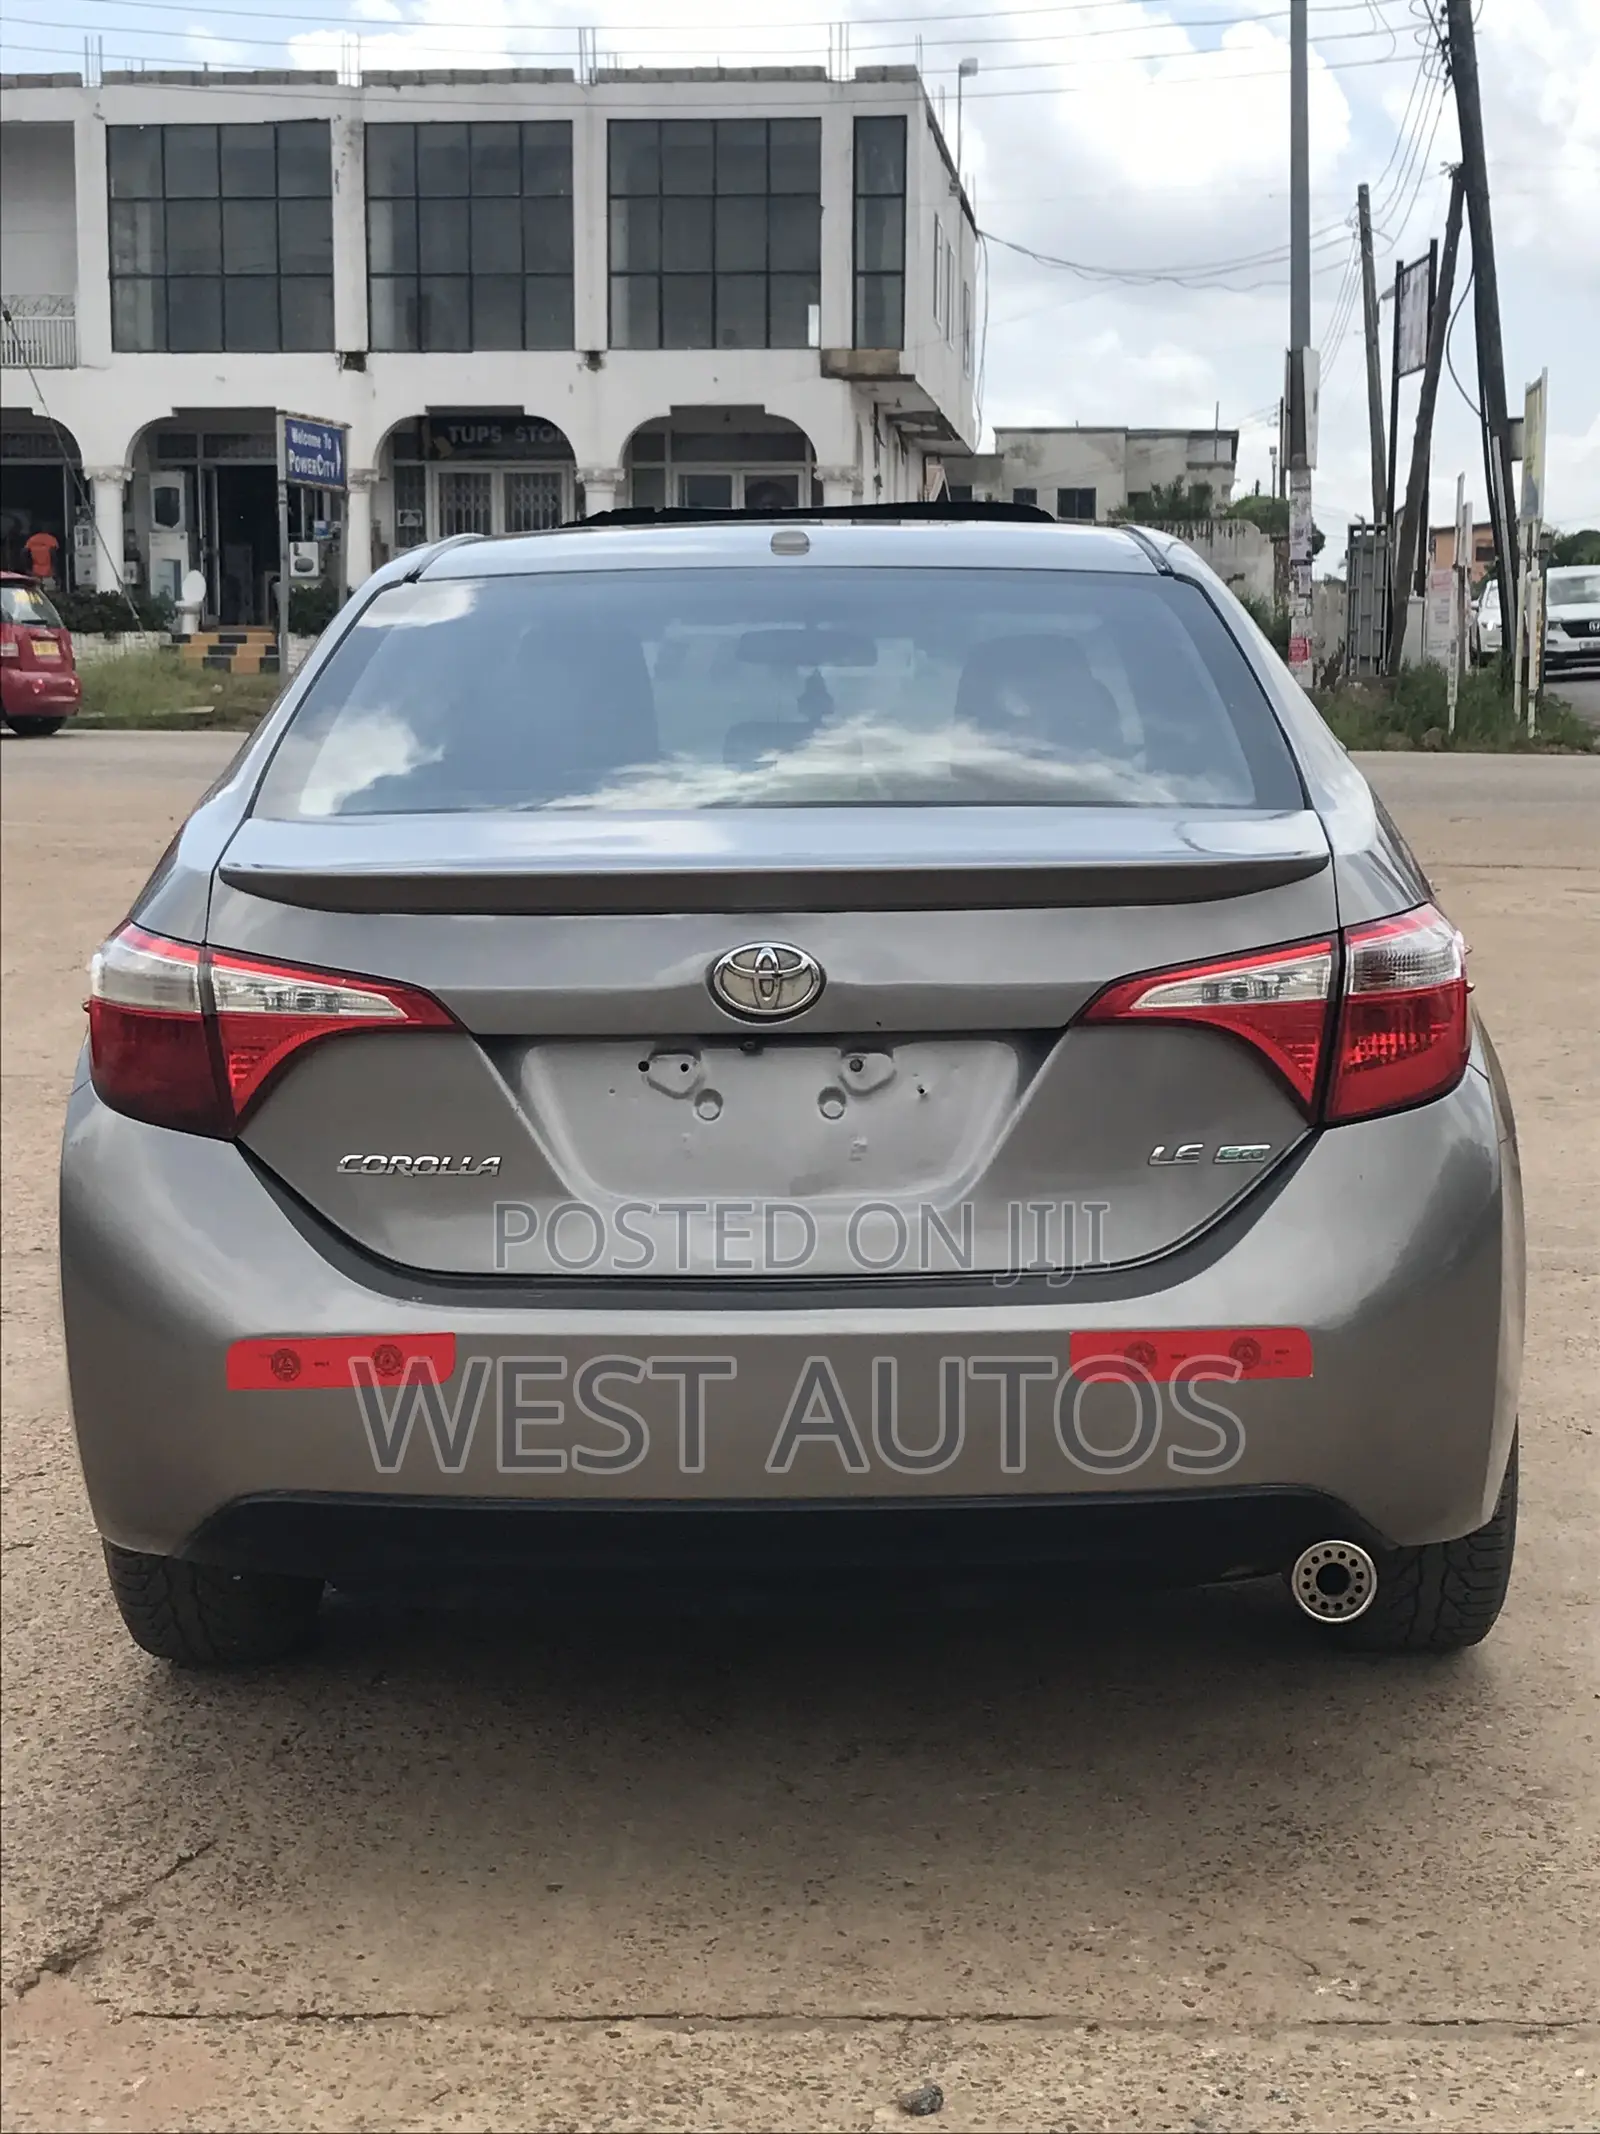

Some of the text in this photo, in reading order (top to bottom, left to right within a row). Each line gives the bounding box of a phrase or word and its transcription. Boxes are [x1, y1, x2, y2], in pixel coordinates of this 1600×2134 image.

[291, 427, 332, 450] Welcome To
[448, 425, 502, 443] TUPS
[336, 1154, 502, 1177] COROLLA
[1148, 1143, 1204, 1166] LE
